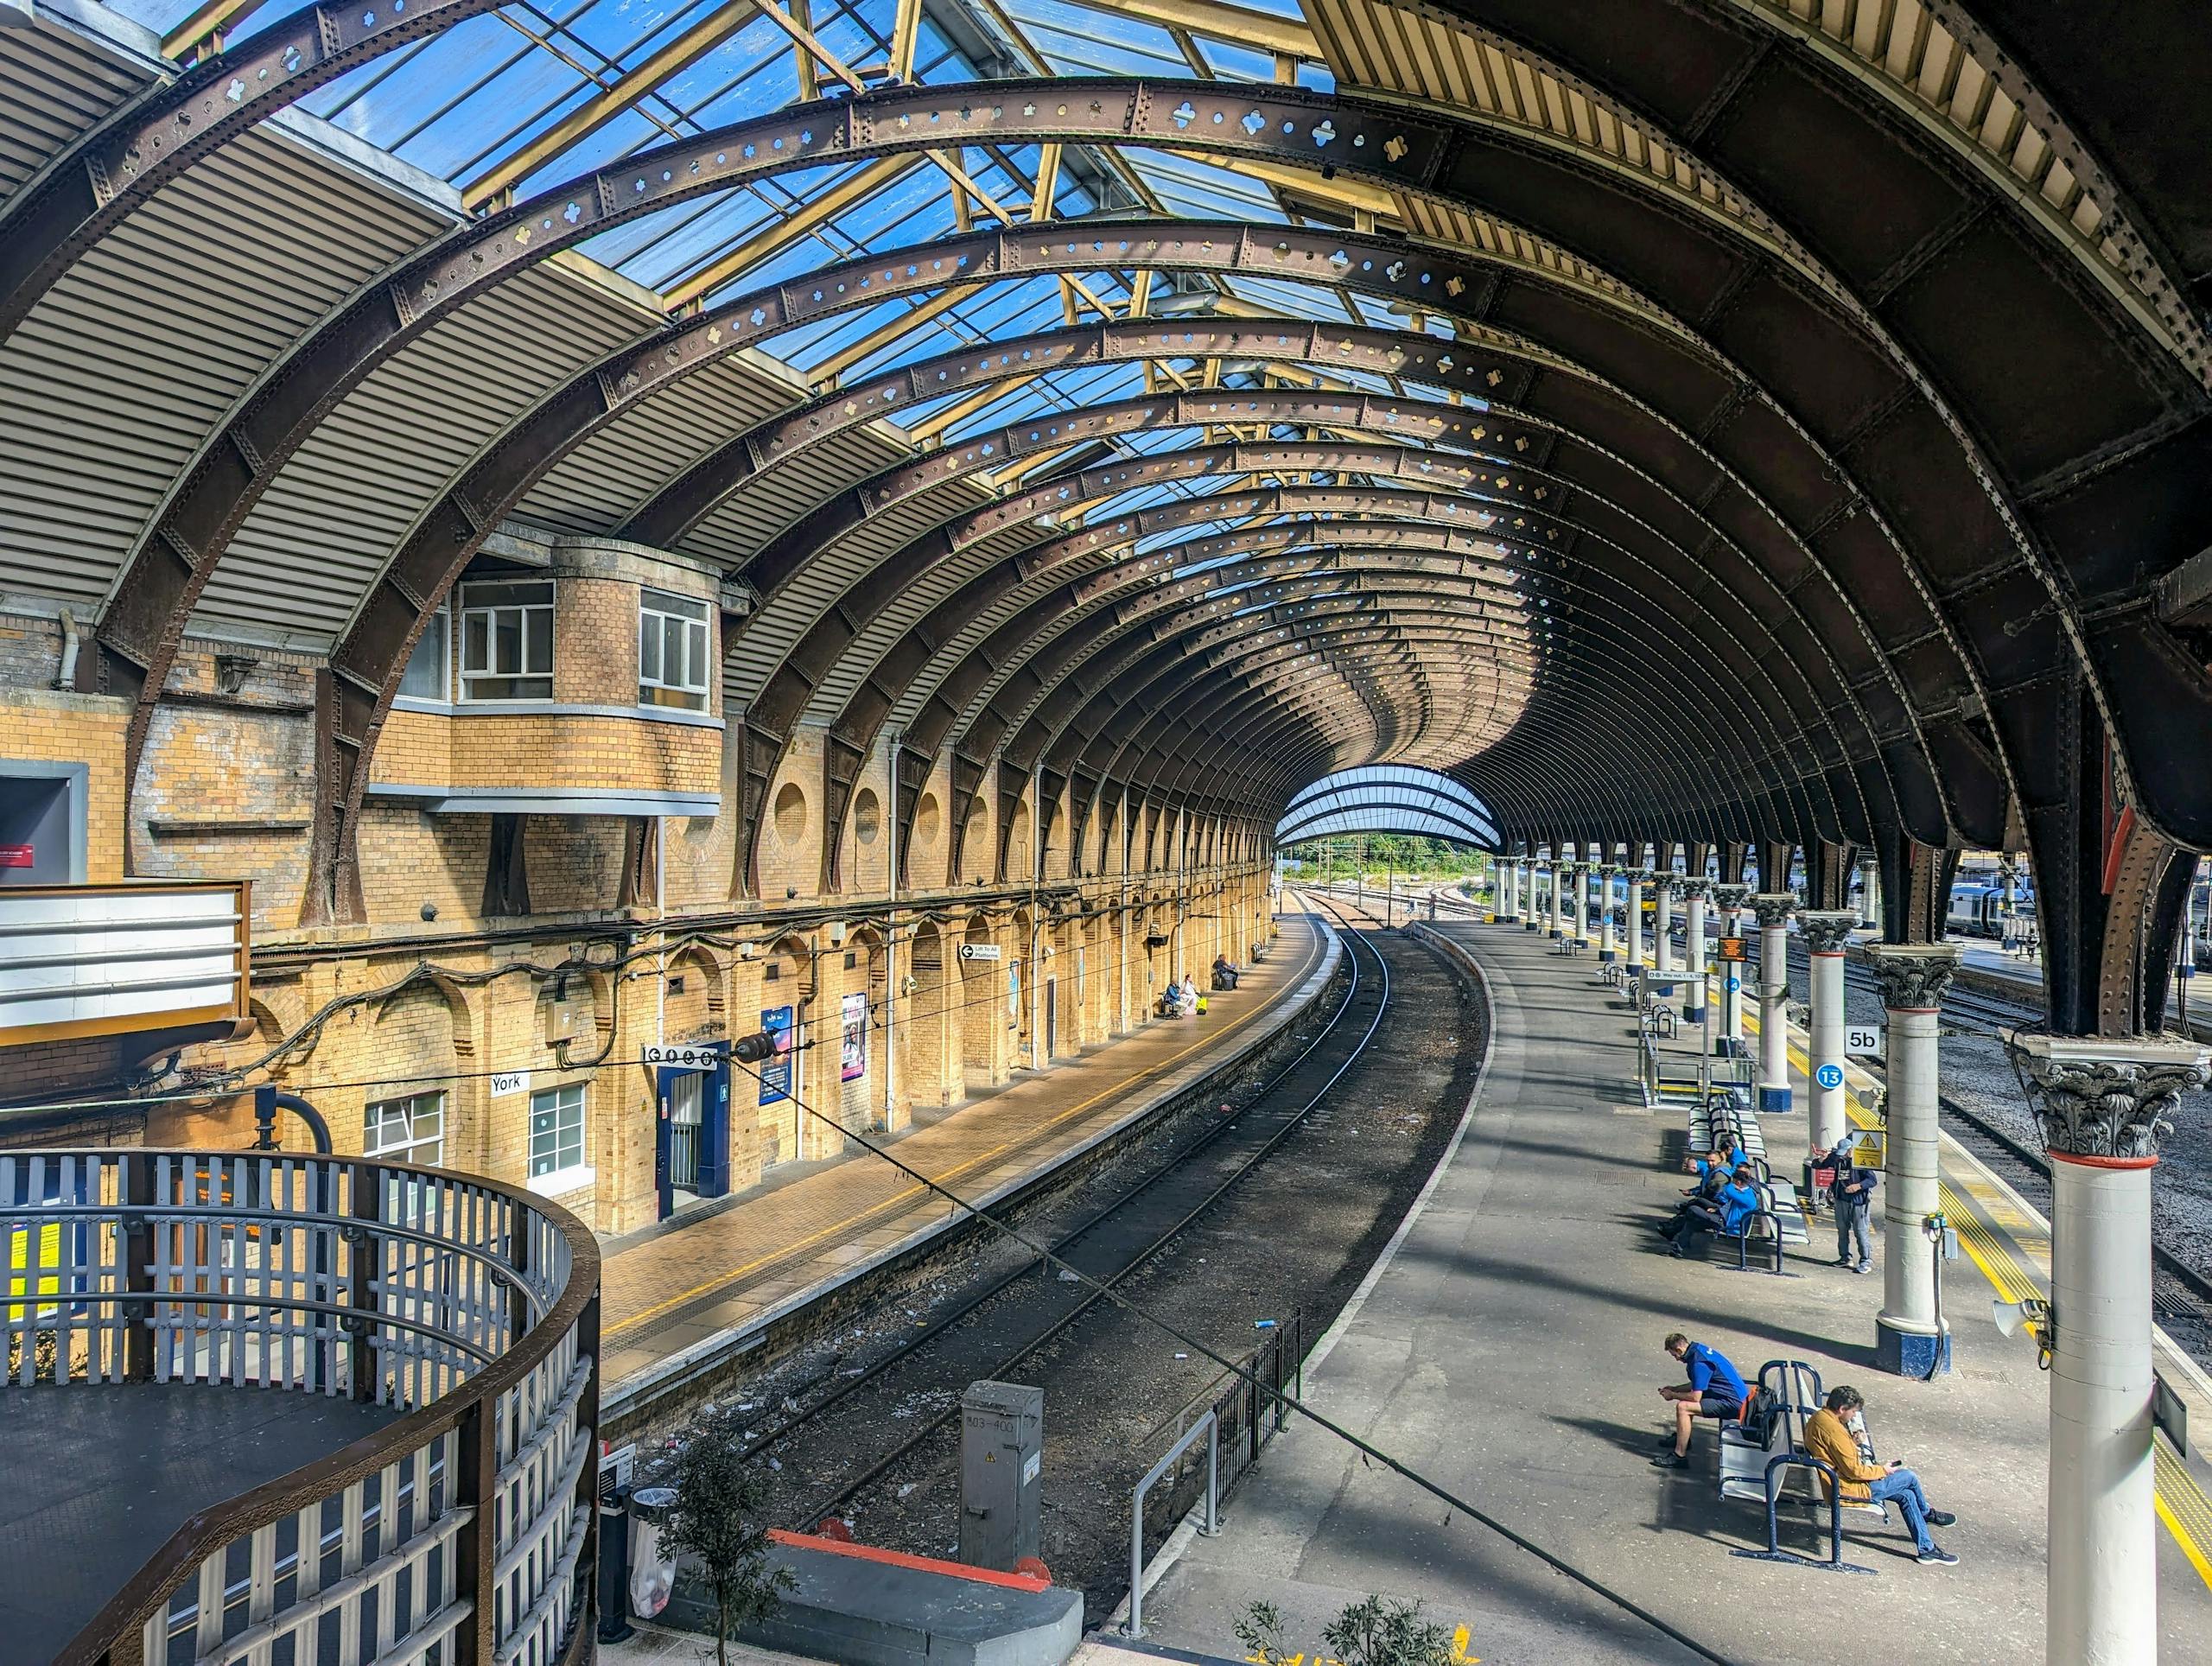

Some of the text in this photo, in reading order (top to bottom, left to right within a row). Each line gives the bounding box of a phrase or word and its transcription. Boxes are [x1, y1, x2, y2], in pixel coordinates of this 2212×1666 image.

[1850, 1032, 1876, 1048] 5b
[493, 1074, 520, 1092] York
[1821, 1071, 1840, 1084] 13
